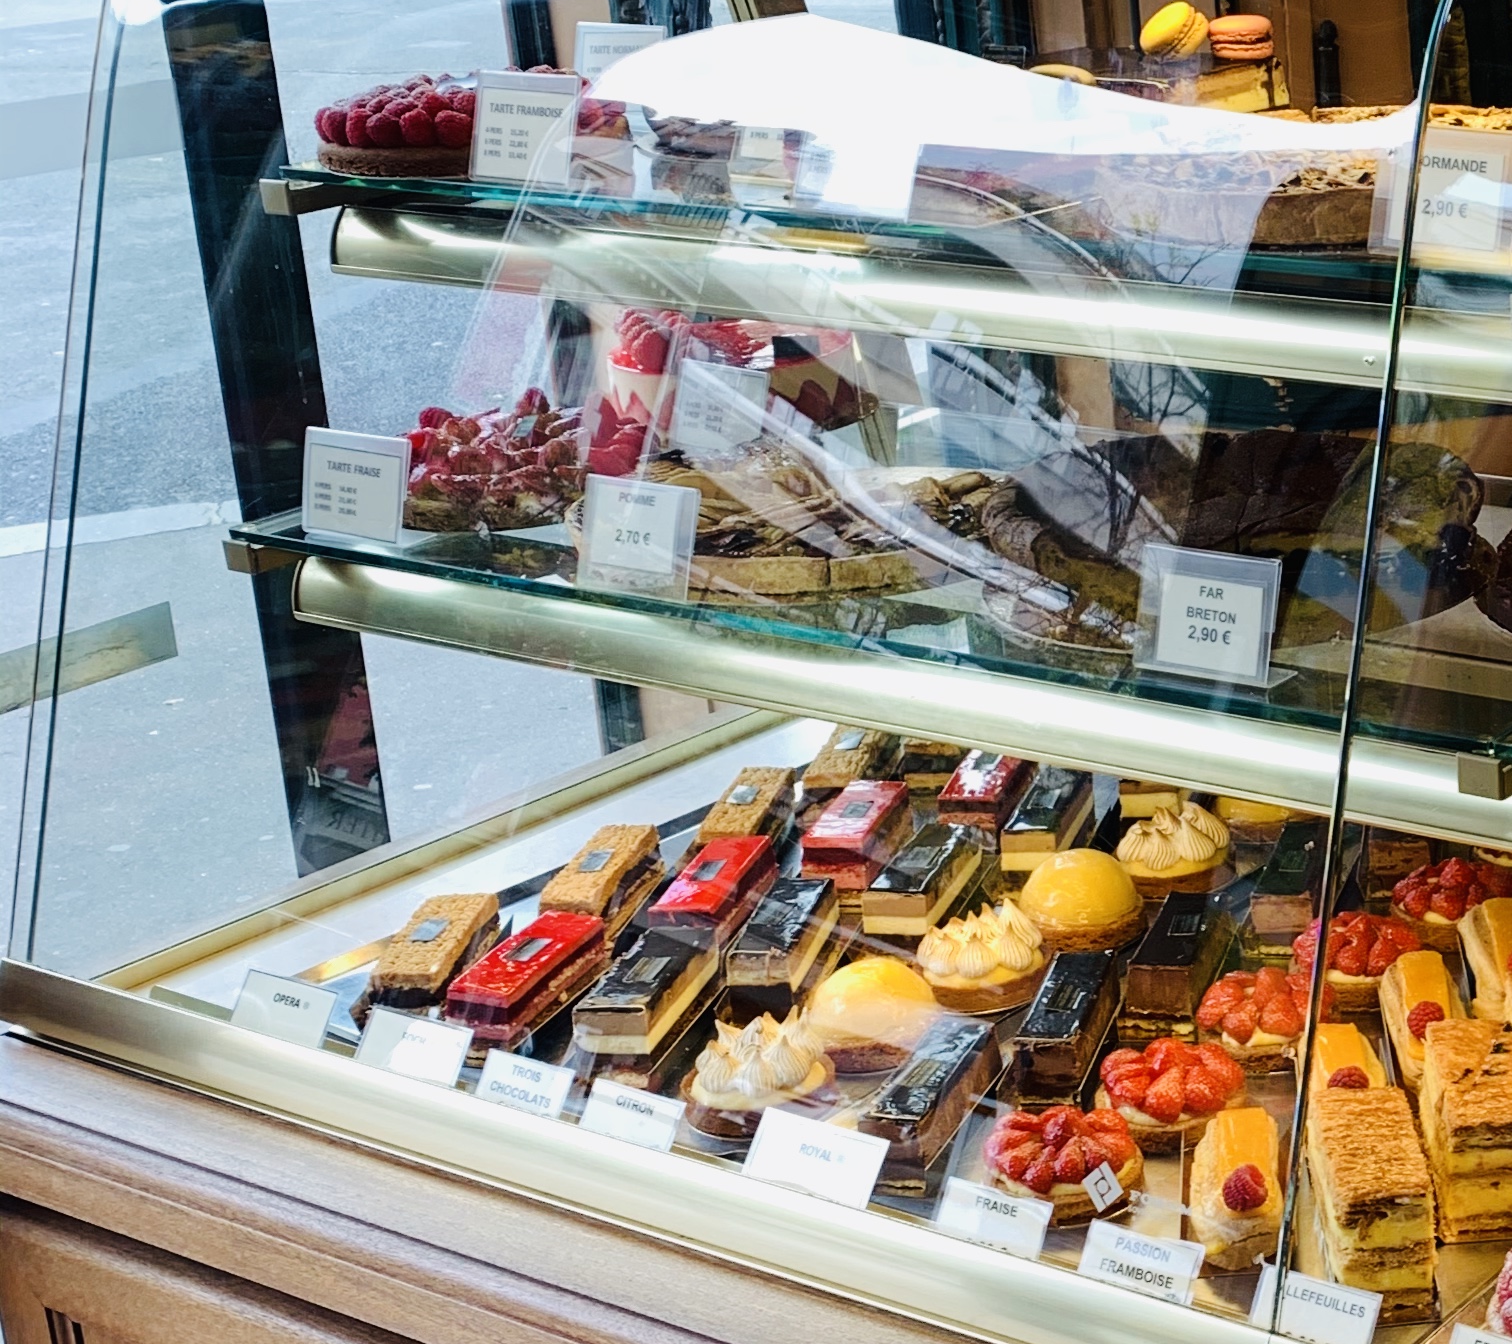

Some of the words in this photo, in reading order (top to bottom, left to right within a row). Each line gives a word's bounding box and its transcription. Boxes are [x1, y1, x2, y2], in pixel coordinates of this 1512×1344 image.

[490, 102, 514, 115] TARTE
[517, 104, 564, 118] FRAMBOISE
[1421, 155, 1488, 174] ORMANDE
[1421, 198, 1454, 219] 2,90
[1458, 203, 1469, 219] €
[327, 460, 351, 474] TARTE
[354, 465, 381, 478] FRAISE
[614, 528, 641, 545] 2,70
[1199, 585, 1224, 600] FAR
[1186, 606, 1237, 625] BRETON
[1187, 625, 1218, 644] 2,90
[1222, 630, 1232, 645] €
[273, 992, 300, 1010] OPERA
[512, 1065, 542, 1083] TROIS
[490, 1080, 552, 1109] CHOCOLATS
[616, 1095, 656, 1117] CITRON
[799, 1143, 832, 1163] ROYAL
[975, 1195, 1018, 1218] FRAISE
[1114, 1237, 1171, 1263] PASSION
[1100, 1258, 1174, 1289] FRAMBOISE
[1286, 1284, 1366, 1319] LLEFEUILLES
